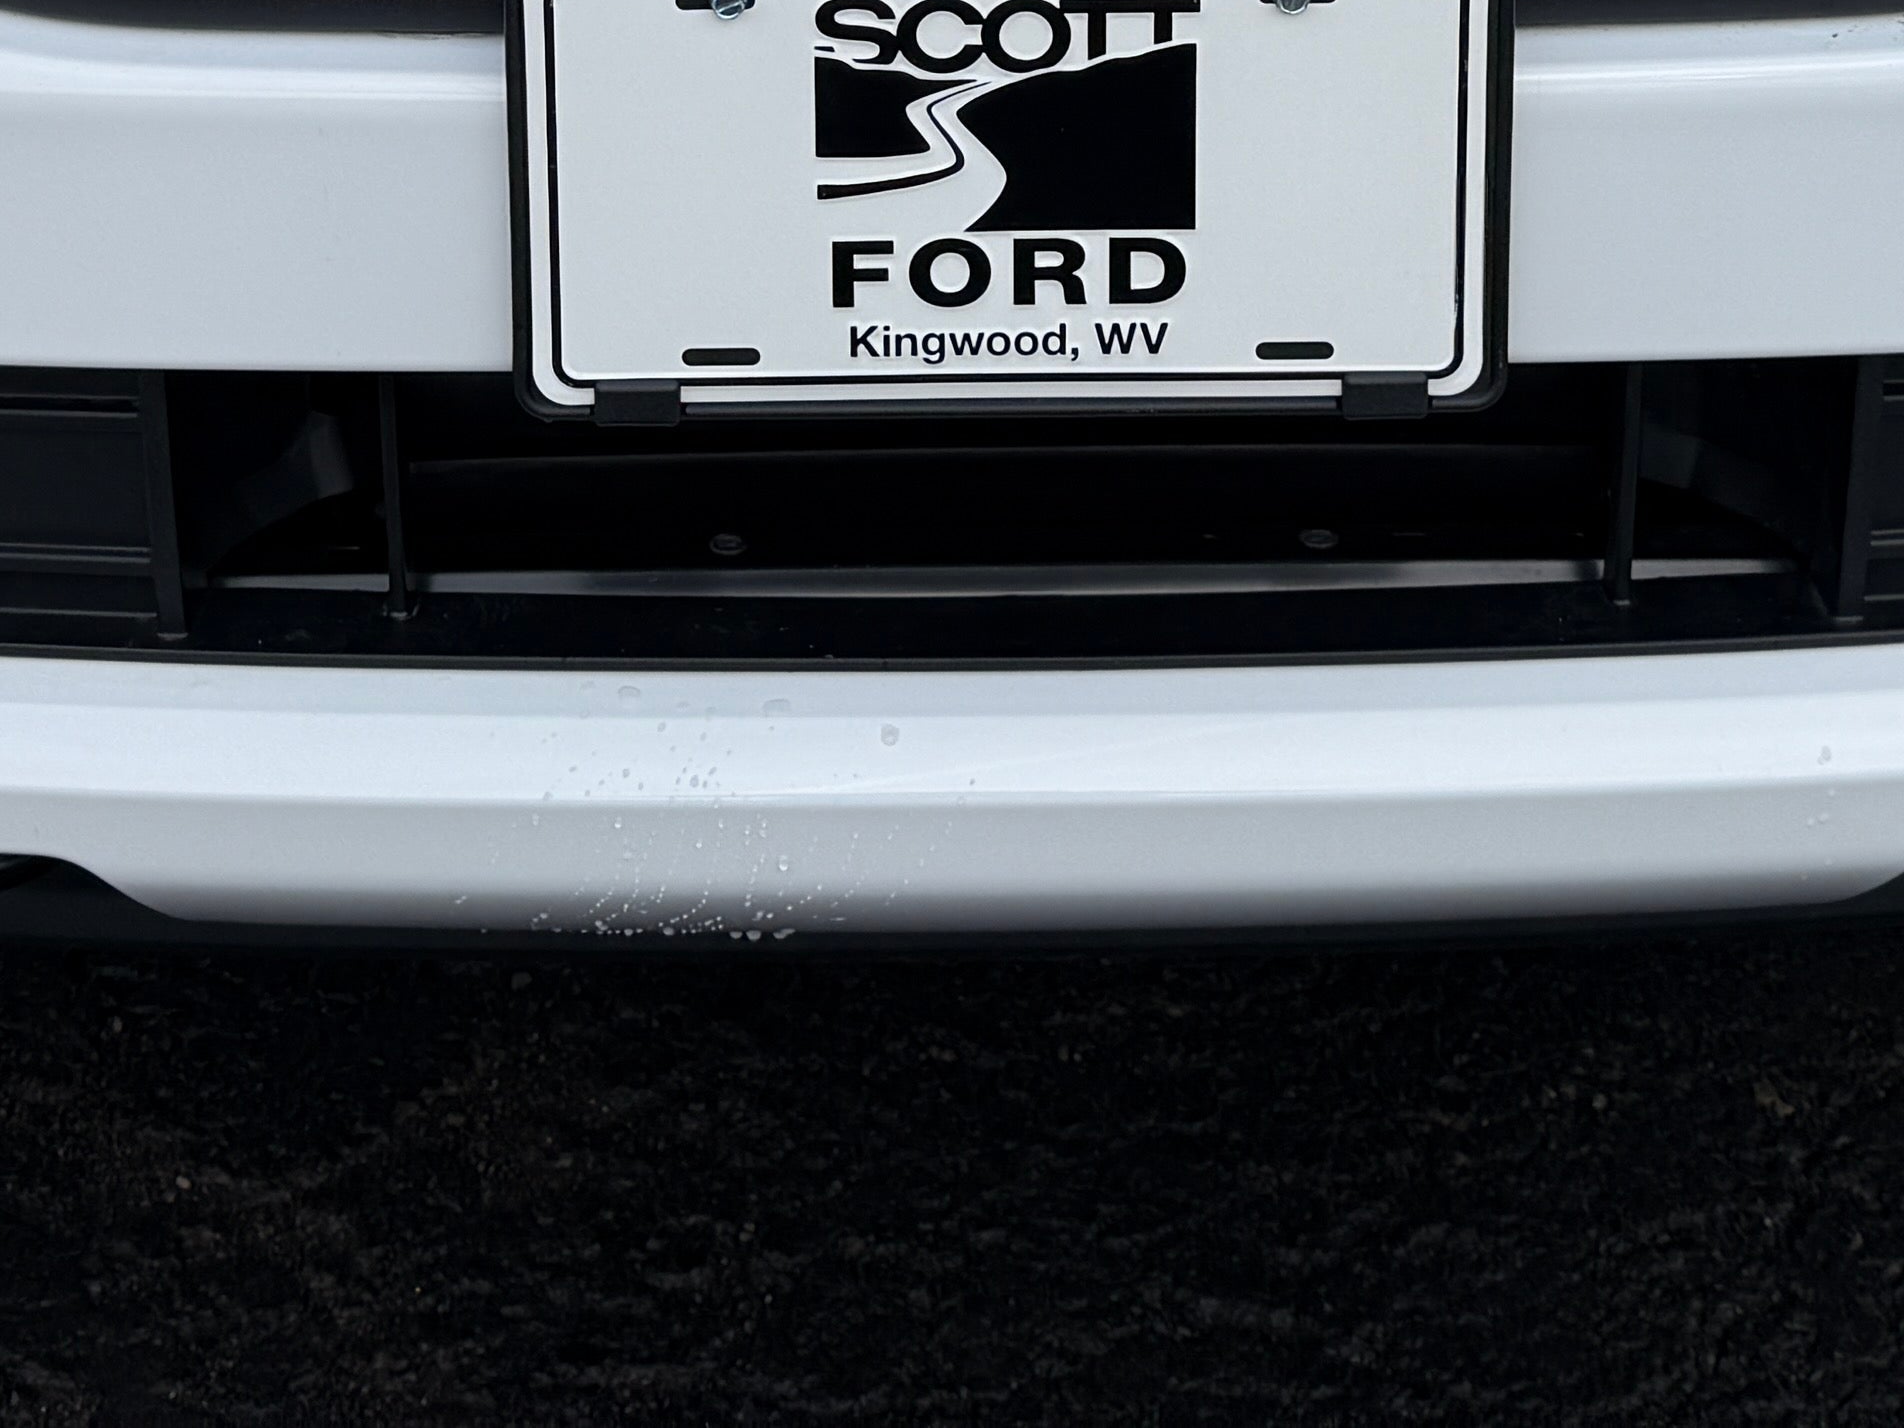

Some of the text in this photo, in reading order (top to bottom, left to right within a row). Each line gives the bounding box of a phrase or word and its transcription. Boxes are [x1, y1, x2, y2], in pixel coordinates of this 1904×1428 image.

[830, 237, 1188, 309] FORD
[848, 321, 1169, 365] Kingwood, WV
